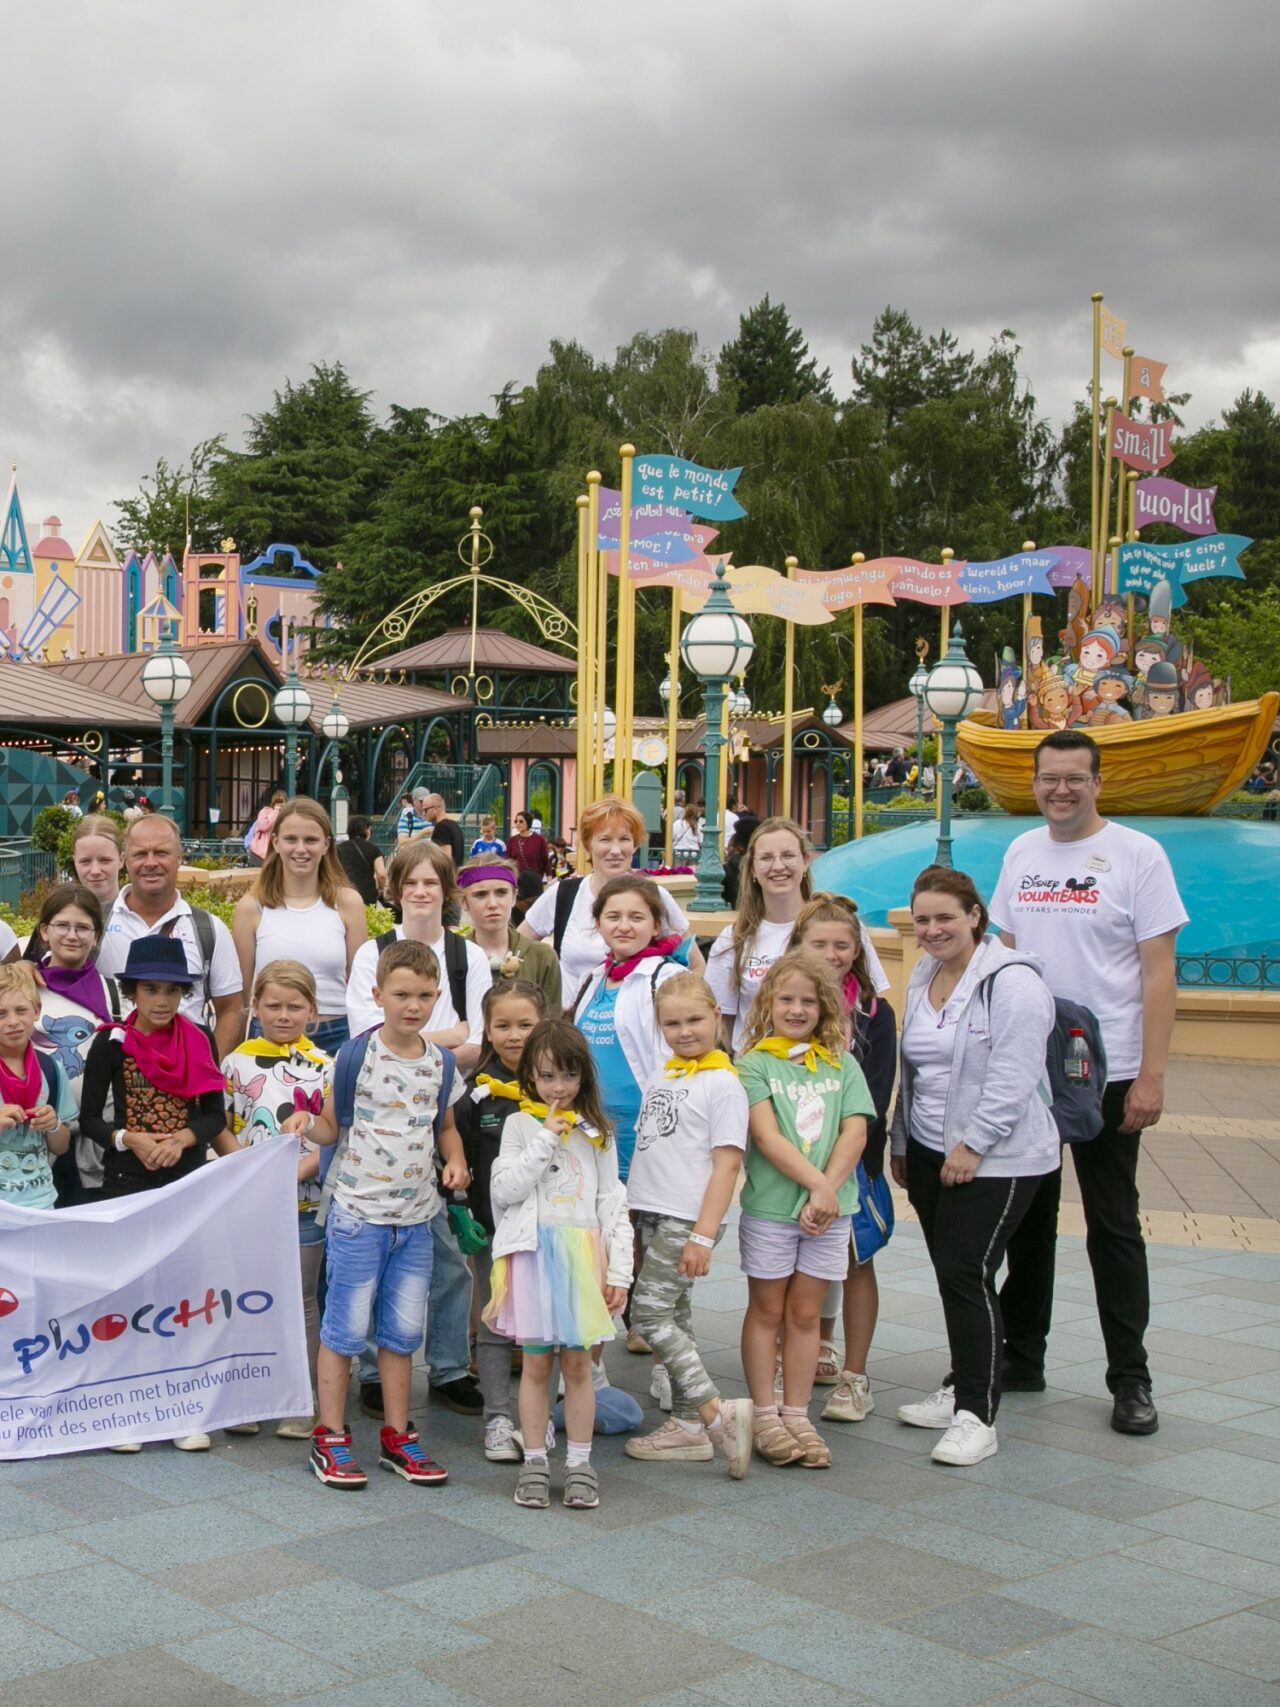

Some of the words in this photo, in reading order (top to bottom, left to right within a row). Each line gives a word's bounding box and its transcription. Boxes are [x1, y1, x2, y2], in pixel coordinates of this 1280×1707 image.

[1140, 367, 1150, 387] a
[1114, 427, 1166, 465] small
[637, 463, 663, 480] que
[668, 463, 680, 478] le
[684, 468, 729, 491] monde
[641, 484, 664, 500] est
[938, 569, 953, 579] es
[1026, 906, 1051, 914] YEARS
[1061, 906, 1098, 915] WONDER
[30, 1405, 53, 1418] van
[56, 1391, 124, 1415] kinderen
[129, 1384, 162, 1403] met
[166, 1363, 271, 1397] brandwonden
[16, 1423, 54, 1441] profit
[59, 1419, 87, 1437] des
[92, 1409, 151, 1431] enfants
[155, 1399, 205, 1422] brûlés
